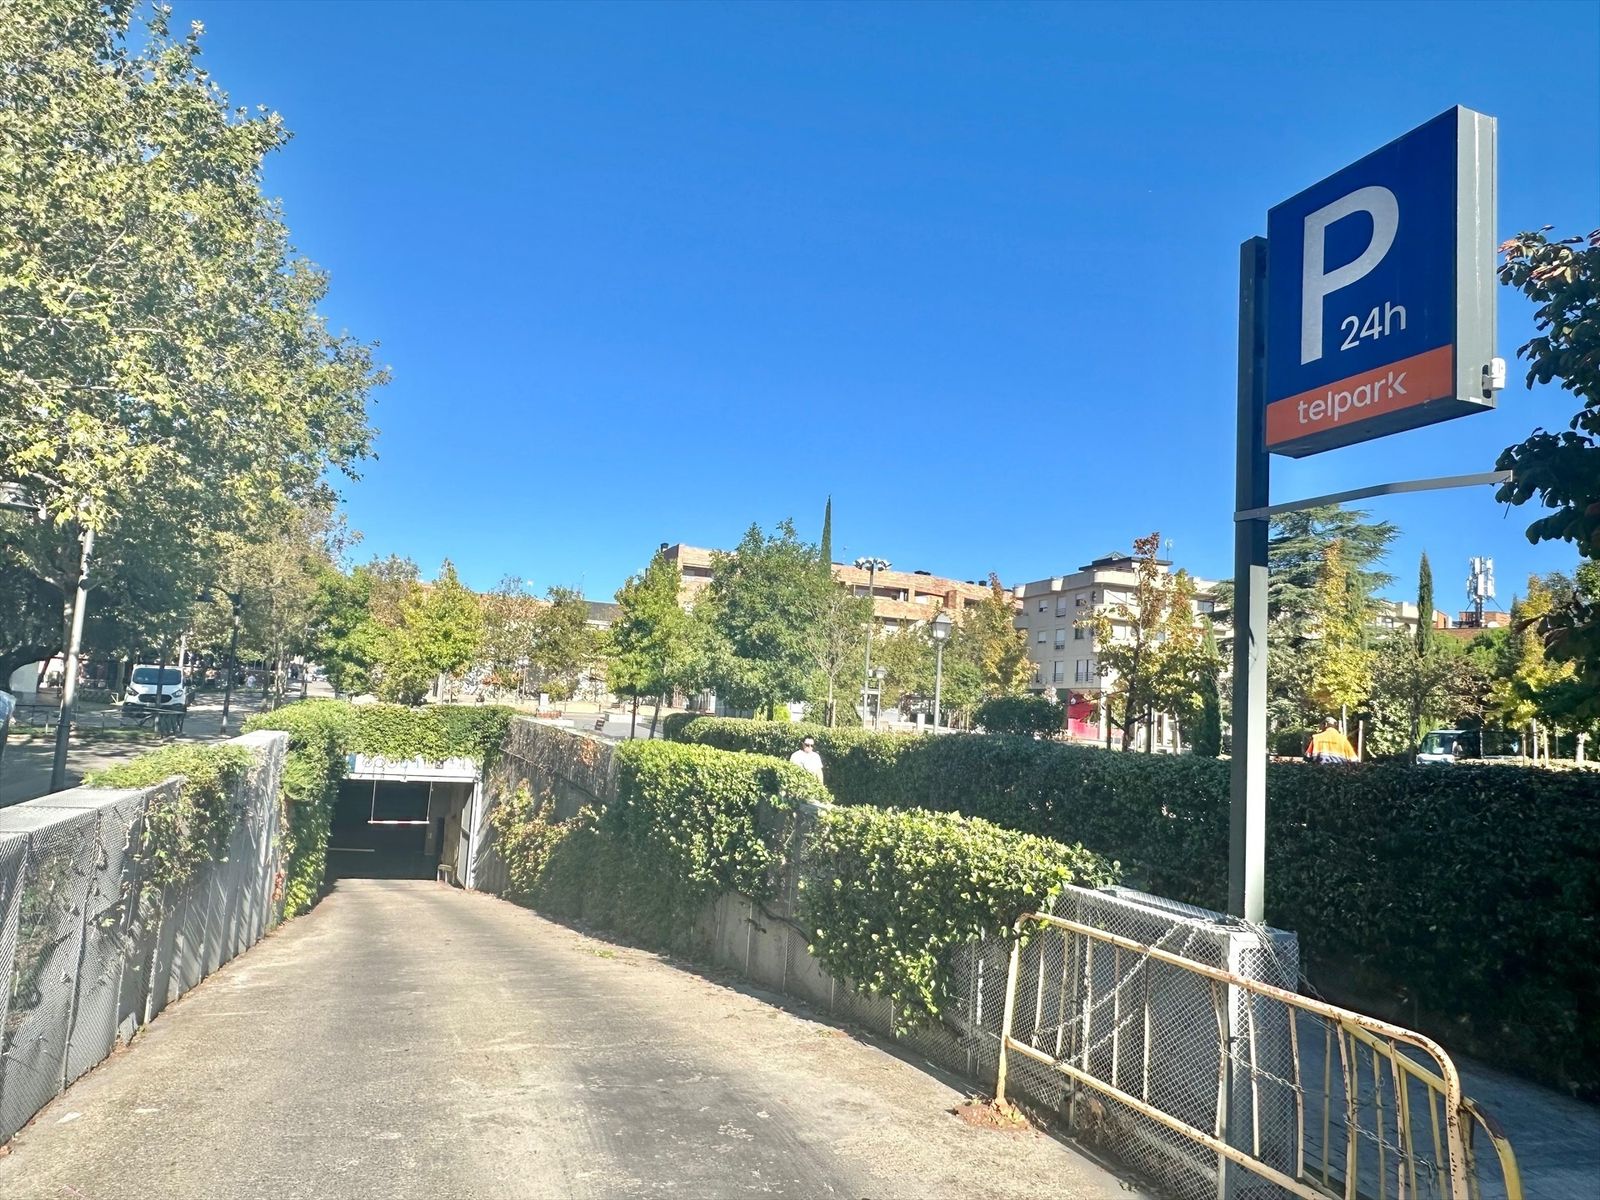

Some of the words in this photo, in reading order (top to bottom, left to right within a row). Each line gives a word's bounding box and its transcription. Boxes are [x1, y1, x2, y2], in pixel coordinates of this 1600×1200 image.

[1301, 186, 1399, 364] P
[1340, 302, 1406, 351] 24h
[1298, 371, 1407, 424] telpark
